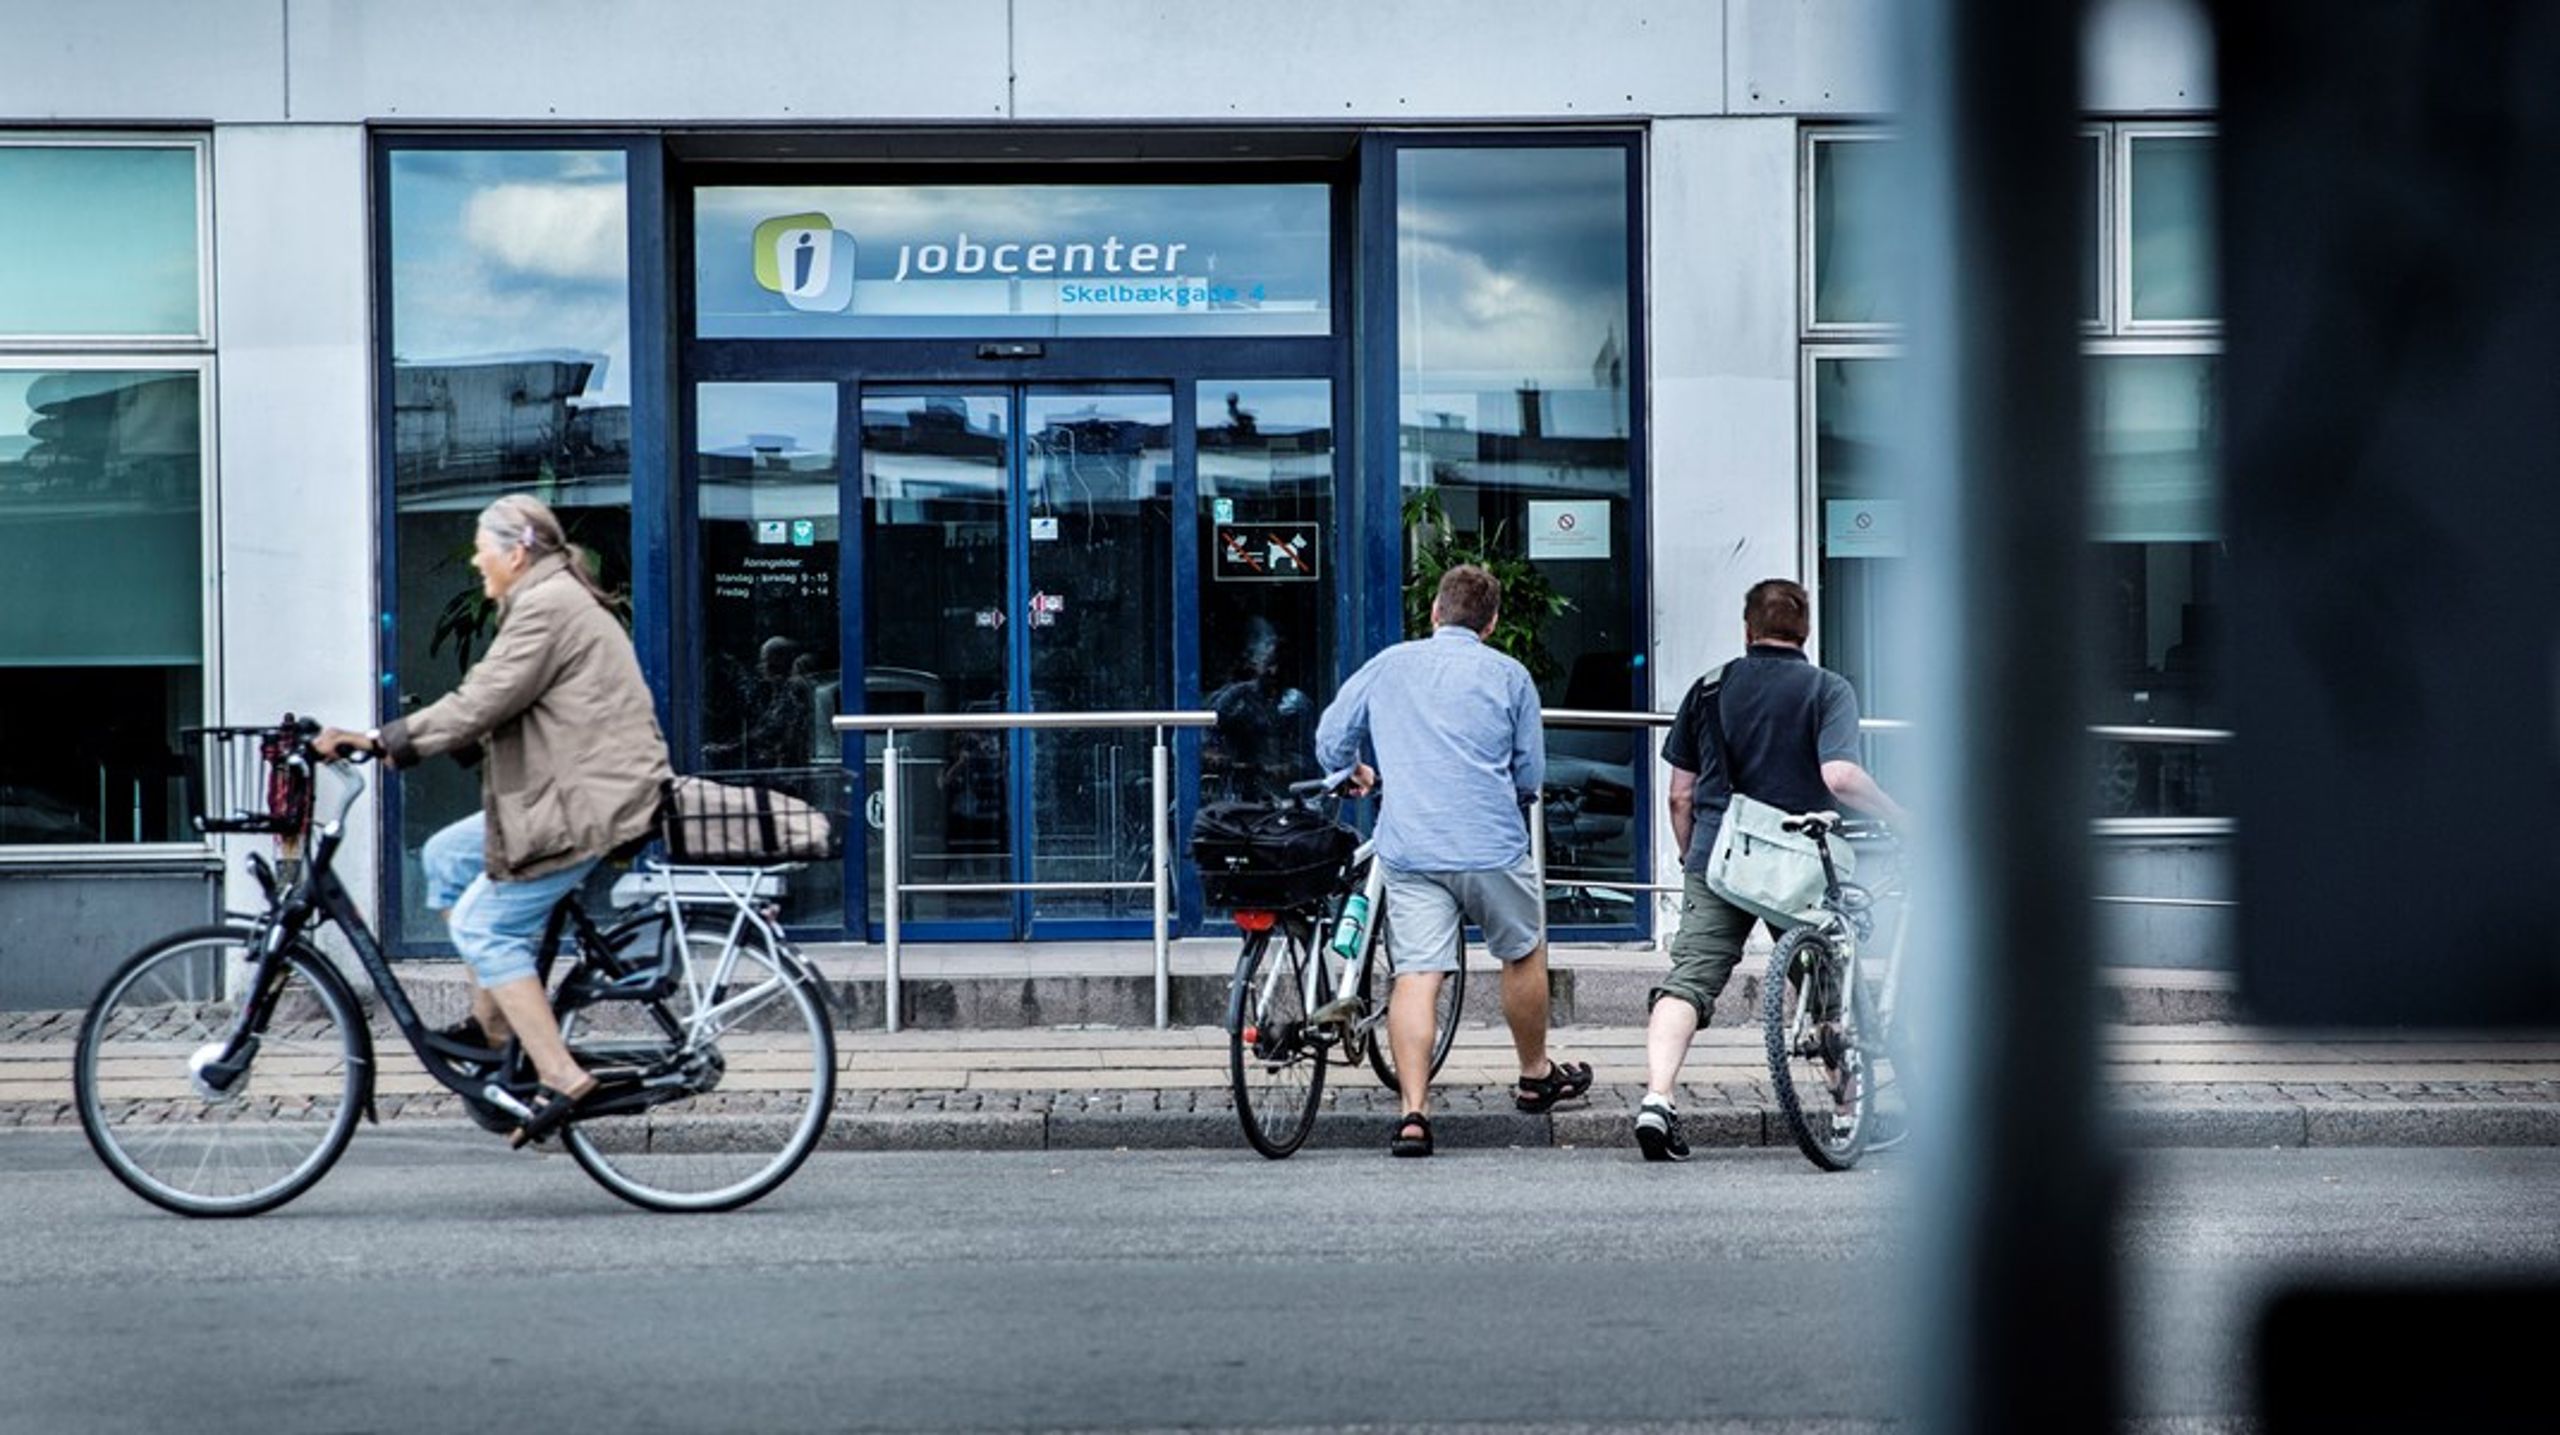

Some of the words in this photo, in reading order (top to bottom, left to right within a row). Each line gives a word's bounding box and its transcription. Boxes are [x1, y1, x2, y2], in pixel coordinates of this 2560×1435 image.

[894, 232, 1188, 283] jobcenter
[1061, 283, 1237, 307] Skelbækgade
[715, 573, 754, 585] Mandag
[716, 586, 750, 599] Fredag
